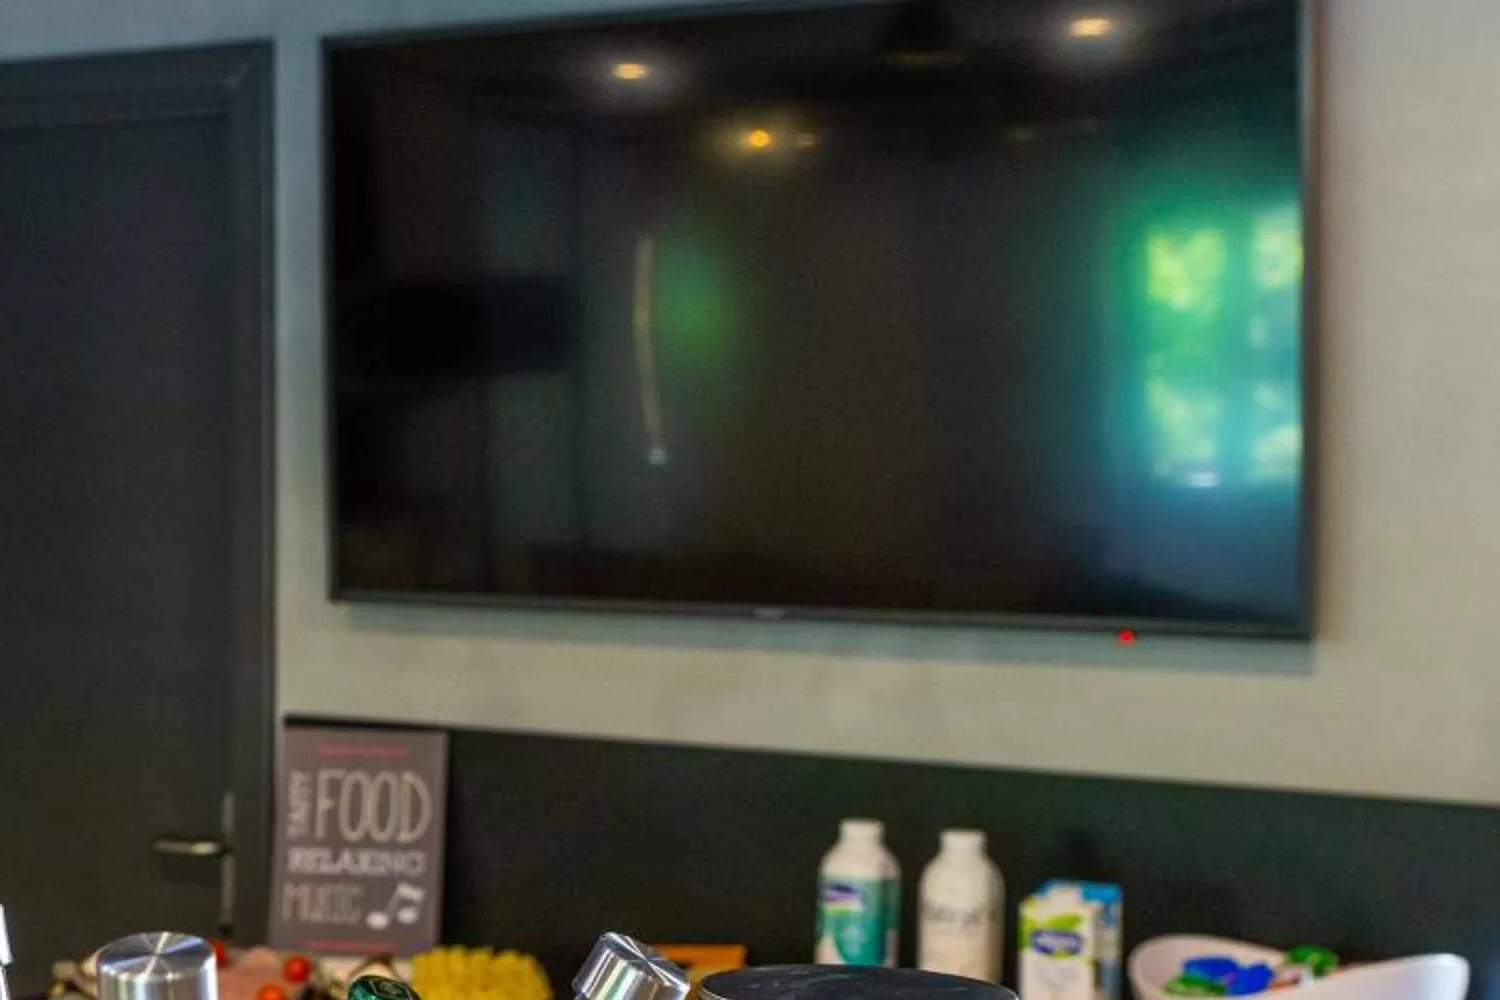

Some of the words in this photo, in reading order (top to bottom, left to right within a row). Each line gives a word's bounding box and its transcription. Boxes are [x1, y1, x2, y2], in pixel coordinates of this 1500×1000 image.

[315, 768, 433, 844] FOOD
[288, 848, 426, 877] RELAXING
[282, 880, 362, 924] MUSIC
